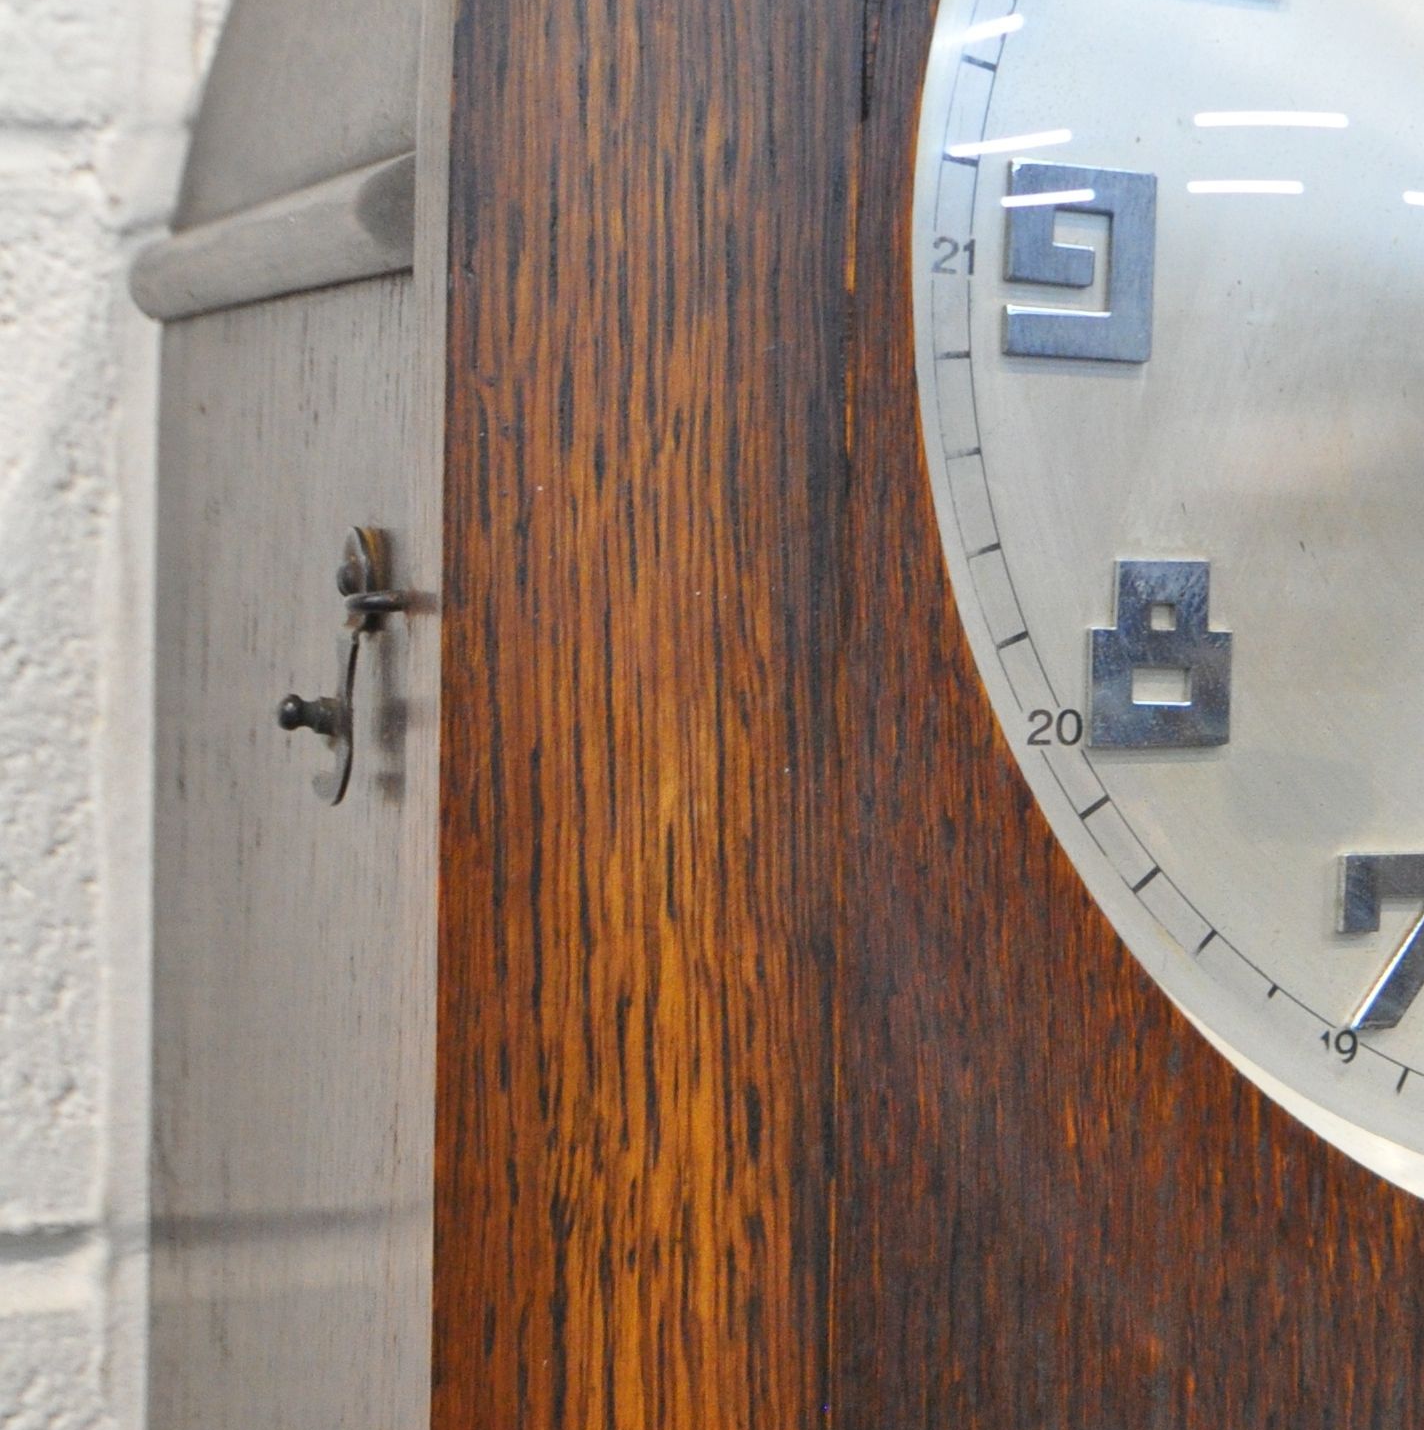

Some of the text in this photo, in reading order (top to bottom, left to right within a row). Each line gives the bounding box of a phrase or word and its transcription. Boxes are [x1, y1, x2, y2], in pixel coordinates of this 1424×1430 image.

[932, 235, 976, 276] 21
[1002, 157, 1157, 362] 9
[1085, 558, 1233, 749] 8
[1026, 708, 1084, 746] 20
[1320, 1029, 1358, 1064] 19
